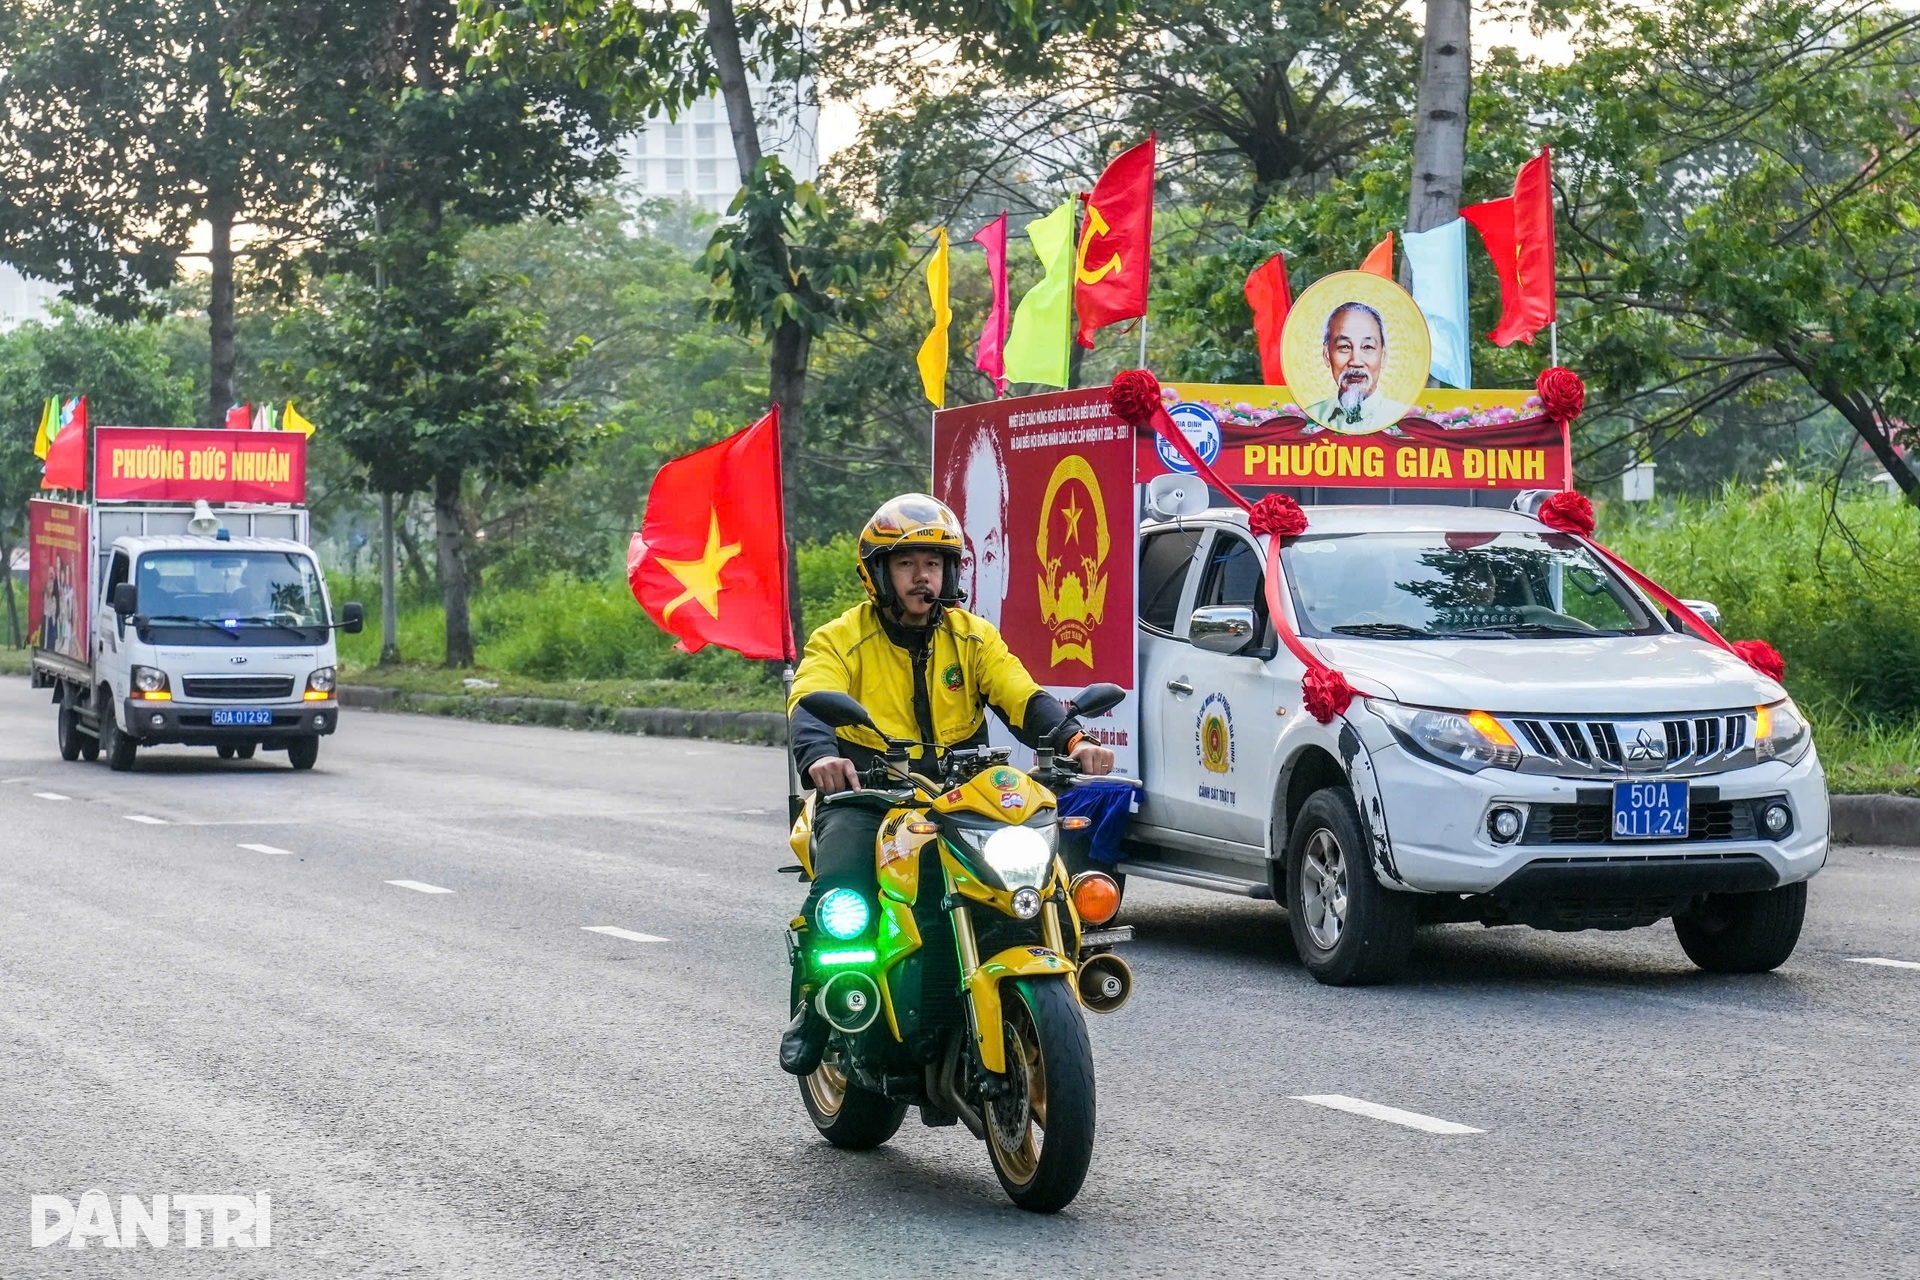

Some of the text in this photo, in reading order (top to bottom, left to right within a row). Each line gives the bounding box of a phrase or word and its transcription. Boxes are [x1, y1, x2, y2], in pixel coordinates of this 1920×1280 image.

[112, 444, 290, 487] PHƯỜNG ĐỨC NHUẬN
[1244, 438, 1545, 486] PHƯỜNG GIA ĐỊNH
[1631, 783, 1669, 808] 50A
[1616, 809, 1685, 835] 011.24
